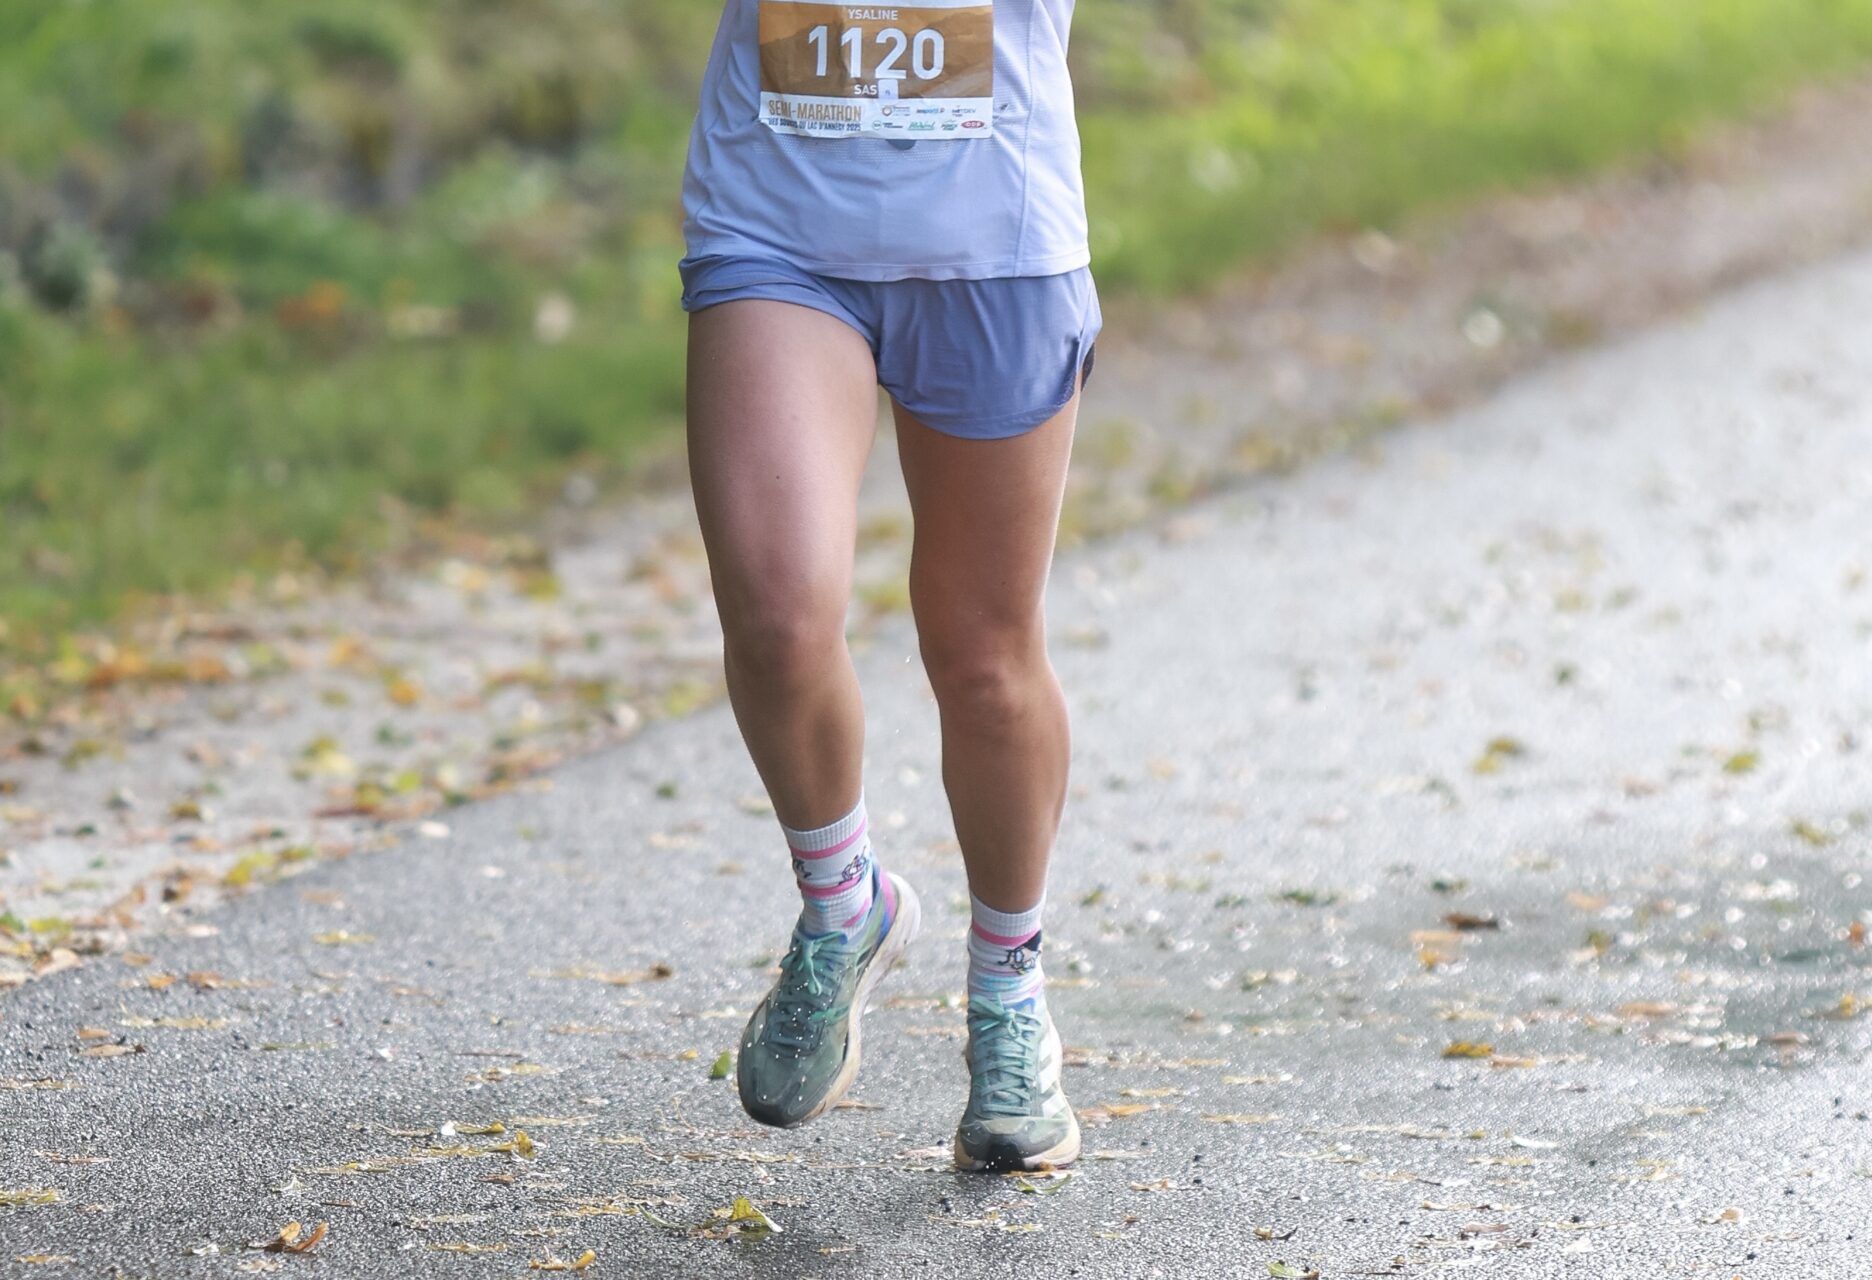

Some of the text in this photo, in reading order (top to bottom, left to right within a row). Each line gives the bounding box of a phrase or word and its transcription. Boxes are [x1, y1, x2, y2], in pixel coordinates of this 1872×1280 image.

[848, 9, 898, 20] YSALINE
[808, 25, 945, 80] 1120
[853, 84, 878, 96] SAS
[768, 100, 861, 121] SEMI-MARATHON
